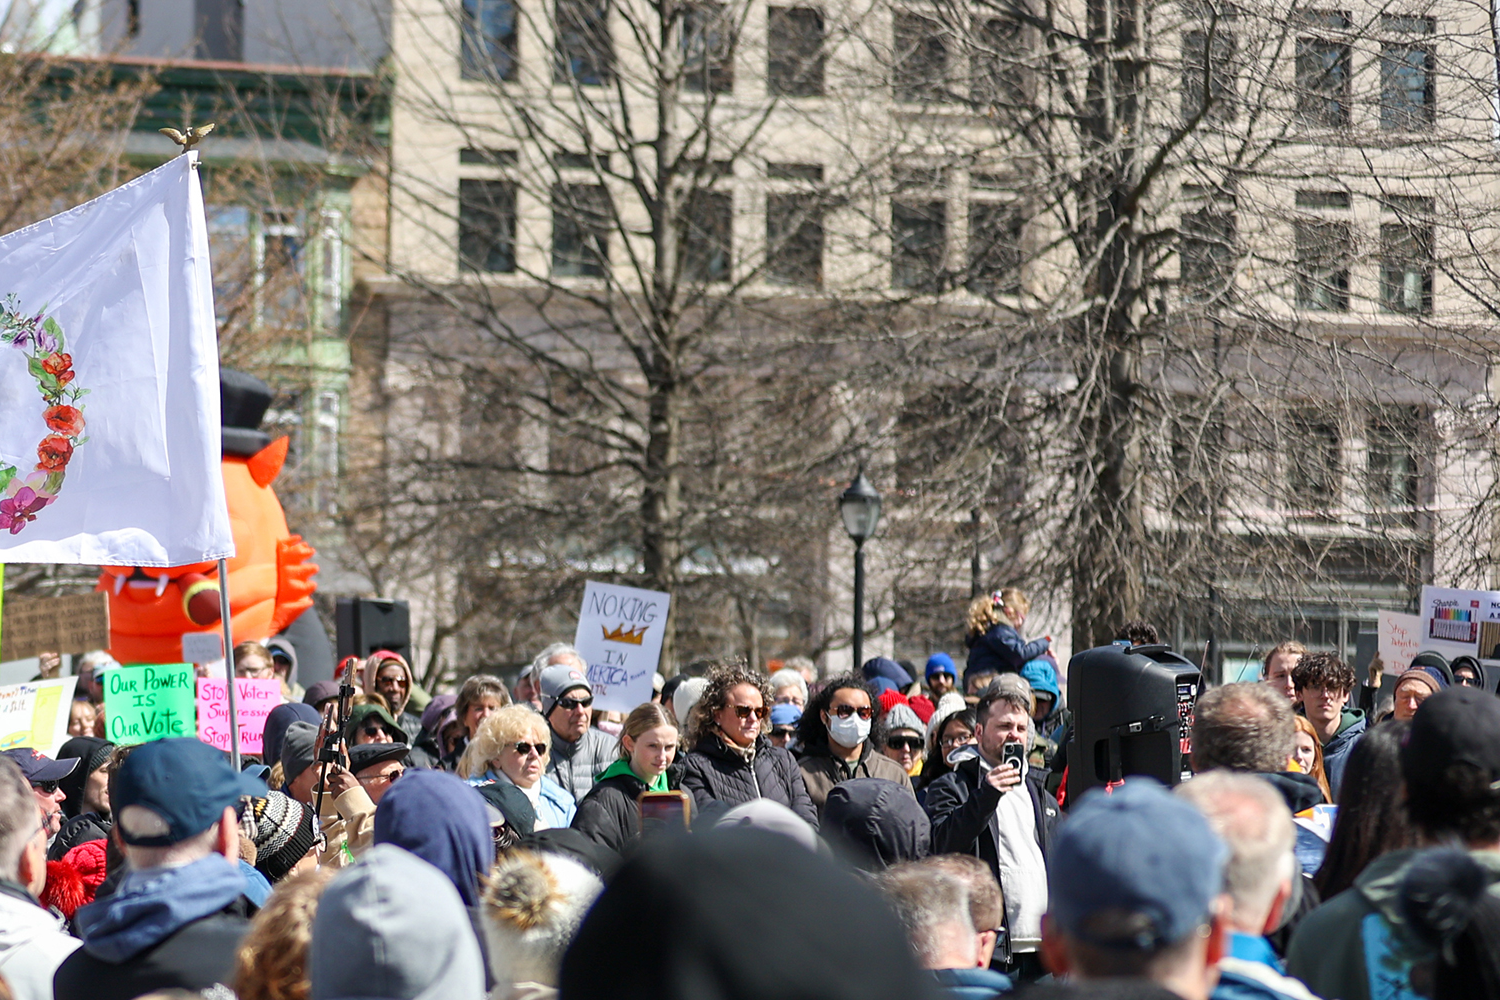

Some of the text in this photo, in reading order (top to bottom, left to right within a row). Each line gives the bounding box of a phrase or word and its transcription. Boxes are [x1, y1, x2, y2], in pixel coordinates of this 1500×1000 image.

[602, 650, 628, 666] IN
[132, 693, 157, 708] IS
[238, 683, 274, 701] Voter
[141, 709, 187, 736] Vote
[204, 726, 231, 749] Stop
